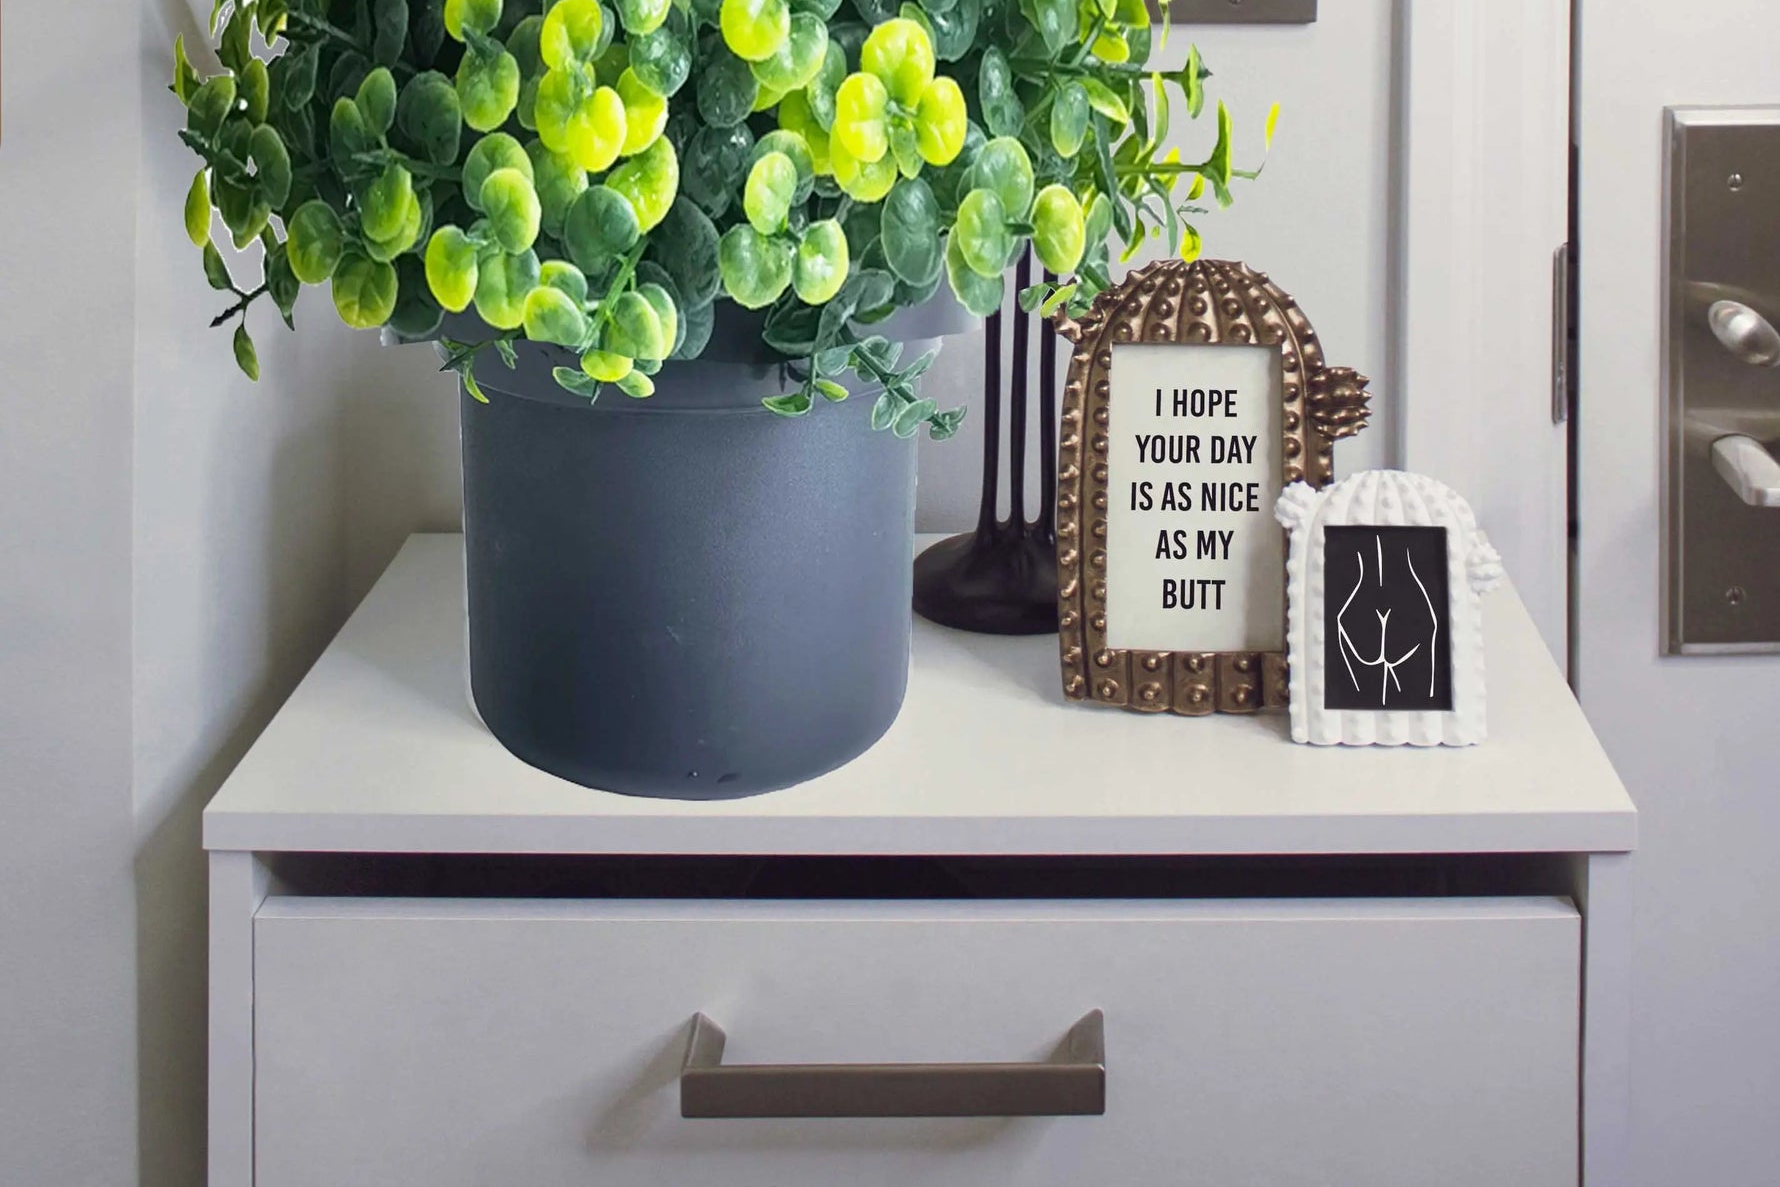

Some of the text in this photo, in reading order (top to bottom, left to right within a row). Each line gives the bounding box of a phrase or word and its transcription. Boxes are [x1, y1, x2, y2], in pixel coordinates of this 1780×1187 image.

[1154, 388, 1238, 418] I HOPE
[1134, 434, 1258, 464] YOUR DAY
[1130, 481, 1260, 512] IS AS NICE
[1155, 529, 1235, 561] AS MY
[1162, 578, 1226, 611] BUTT
